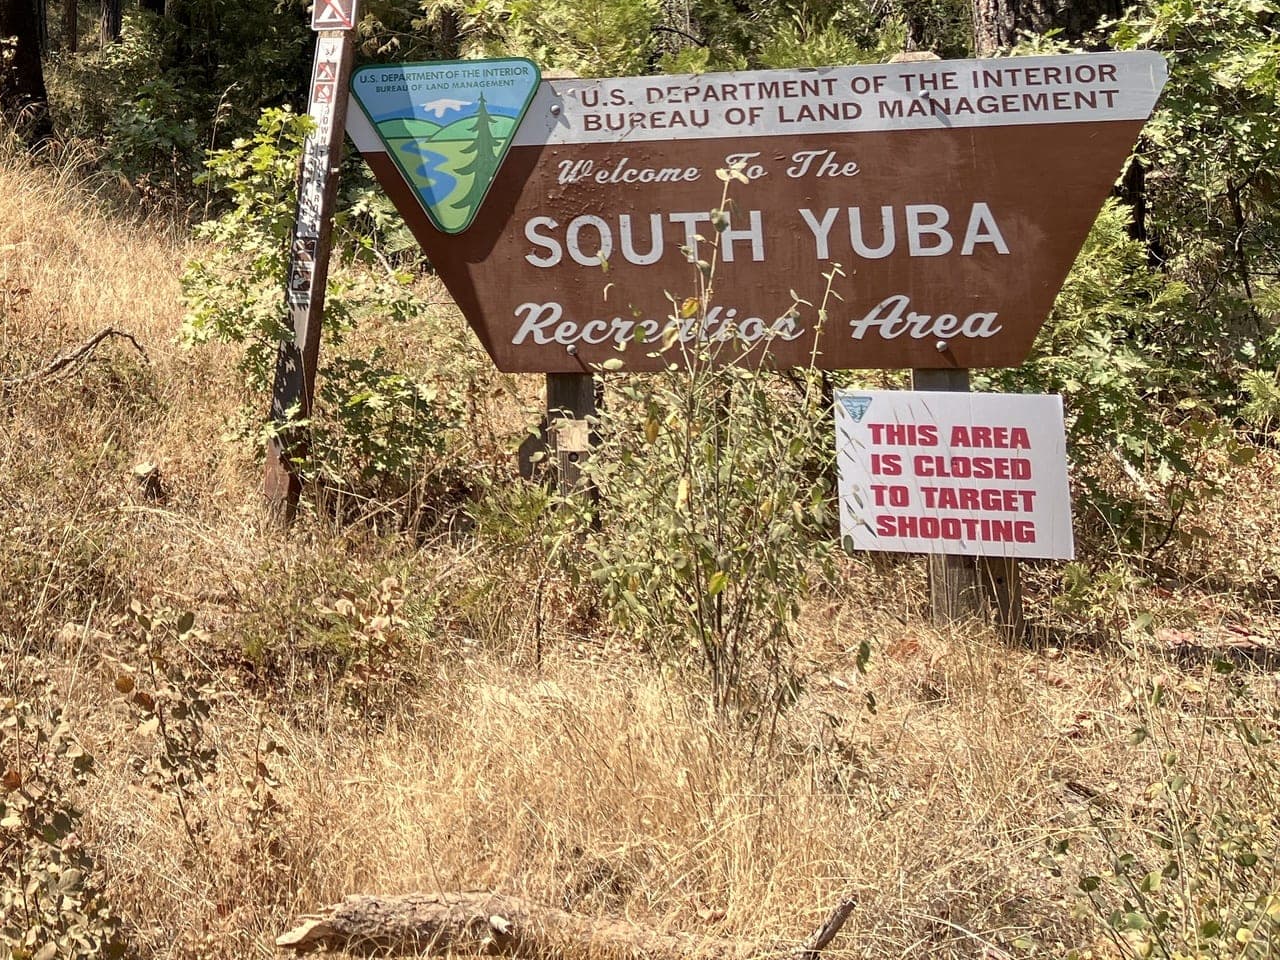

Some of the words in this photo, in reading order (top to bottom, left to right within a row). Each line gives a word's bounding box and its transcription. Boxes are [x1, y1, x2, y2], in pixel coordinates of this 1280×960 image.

[360, 74, 377, 83] U.S.
[381, 71, 445, 82] DEPARTMENT
[445, 70, 460, 79] OF
[462, 69, 480, 78] THE
[482, 66, 529, 77] INTERIOR
[375, 84, 409, 93] BUREAU
[411, 83, 423, 91] OF
[426, 82, 450, 91] LAND
[452, 79, 514, 89] MANAGEMENT
[581, 88, 633, 107] U.S.
[646, 78, 838, 104] DEPARTMENT
[851, 75, 887, 94] OF
[899, 71, 959, 92] THE
[972, 63, 1118, 89] INTERIOR
[583, 108, 710, 132] BUREAU
[725, 106, 764, 127] OF
[778, 101, 862, 123] LAND
[878, 90, 1120, 119] MANAGEMENT
[558, 157, 701, 185] Welcome
[786, 149, 860, 179] The
[524, 210, 765, 268] SOUTH
[798, 202, 1010, 260] YUBA
[849, 294, 1002, 340] Area
[868, 424, 938, 447] THIS
[950, 426, 1032, 449] AREA
[871, 454, 902, 476] IS
[914, 456, 1032, 480] CLOSED
[870, 485, 910, 507] TO
[921, 487, 1037, 513] TARGET
[876, 515, 1036, 543] SHOOTING
